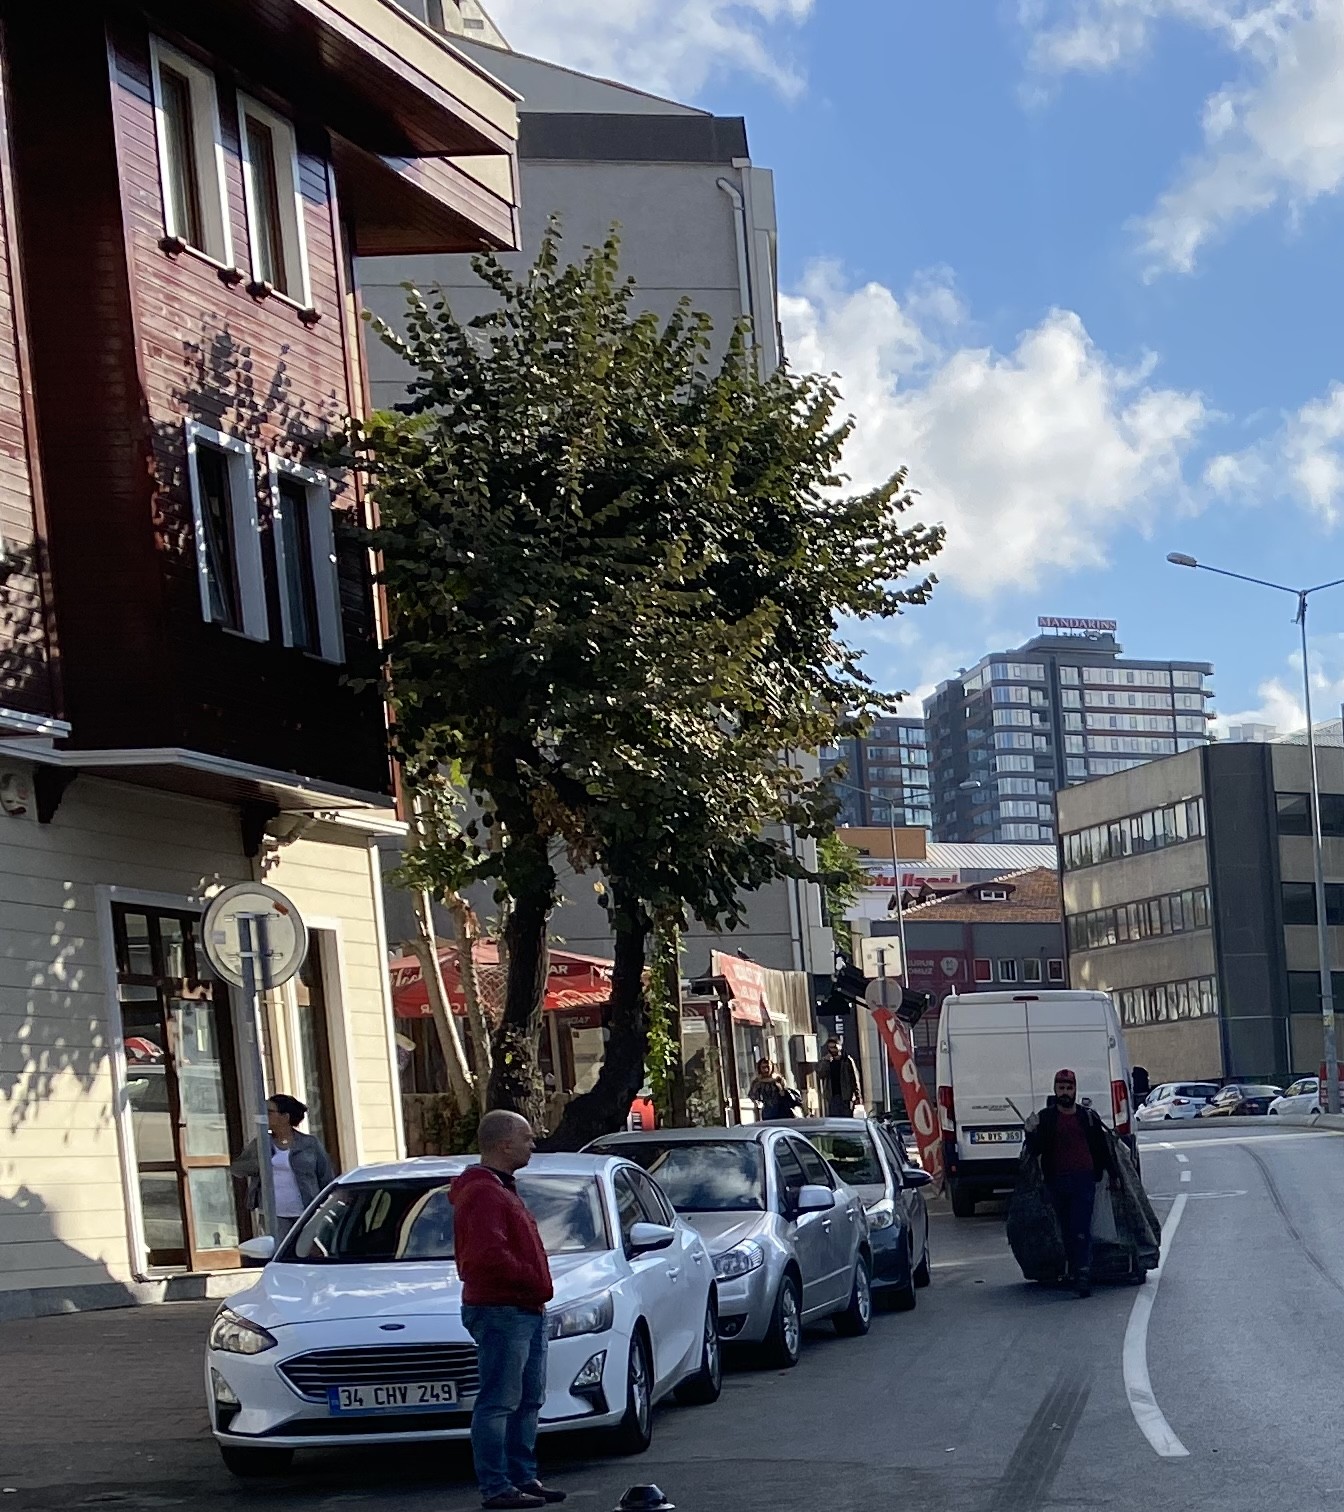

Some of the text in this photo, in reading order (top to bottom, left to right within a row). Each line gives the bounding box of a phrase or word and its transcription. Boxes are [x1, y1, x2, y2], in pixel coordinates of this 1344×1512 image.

[1039, 616, 1116, 630] MANDARINS
[341, 1384, 452, 1407] 34 CHV 249
